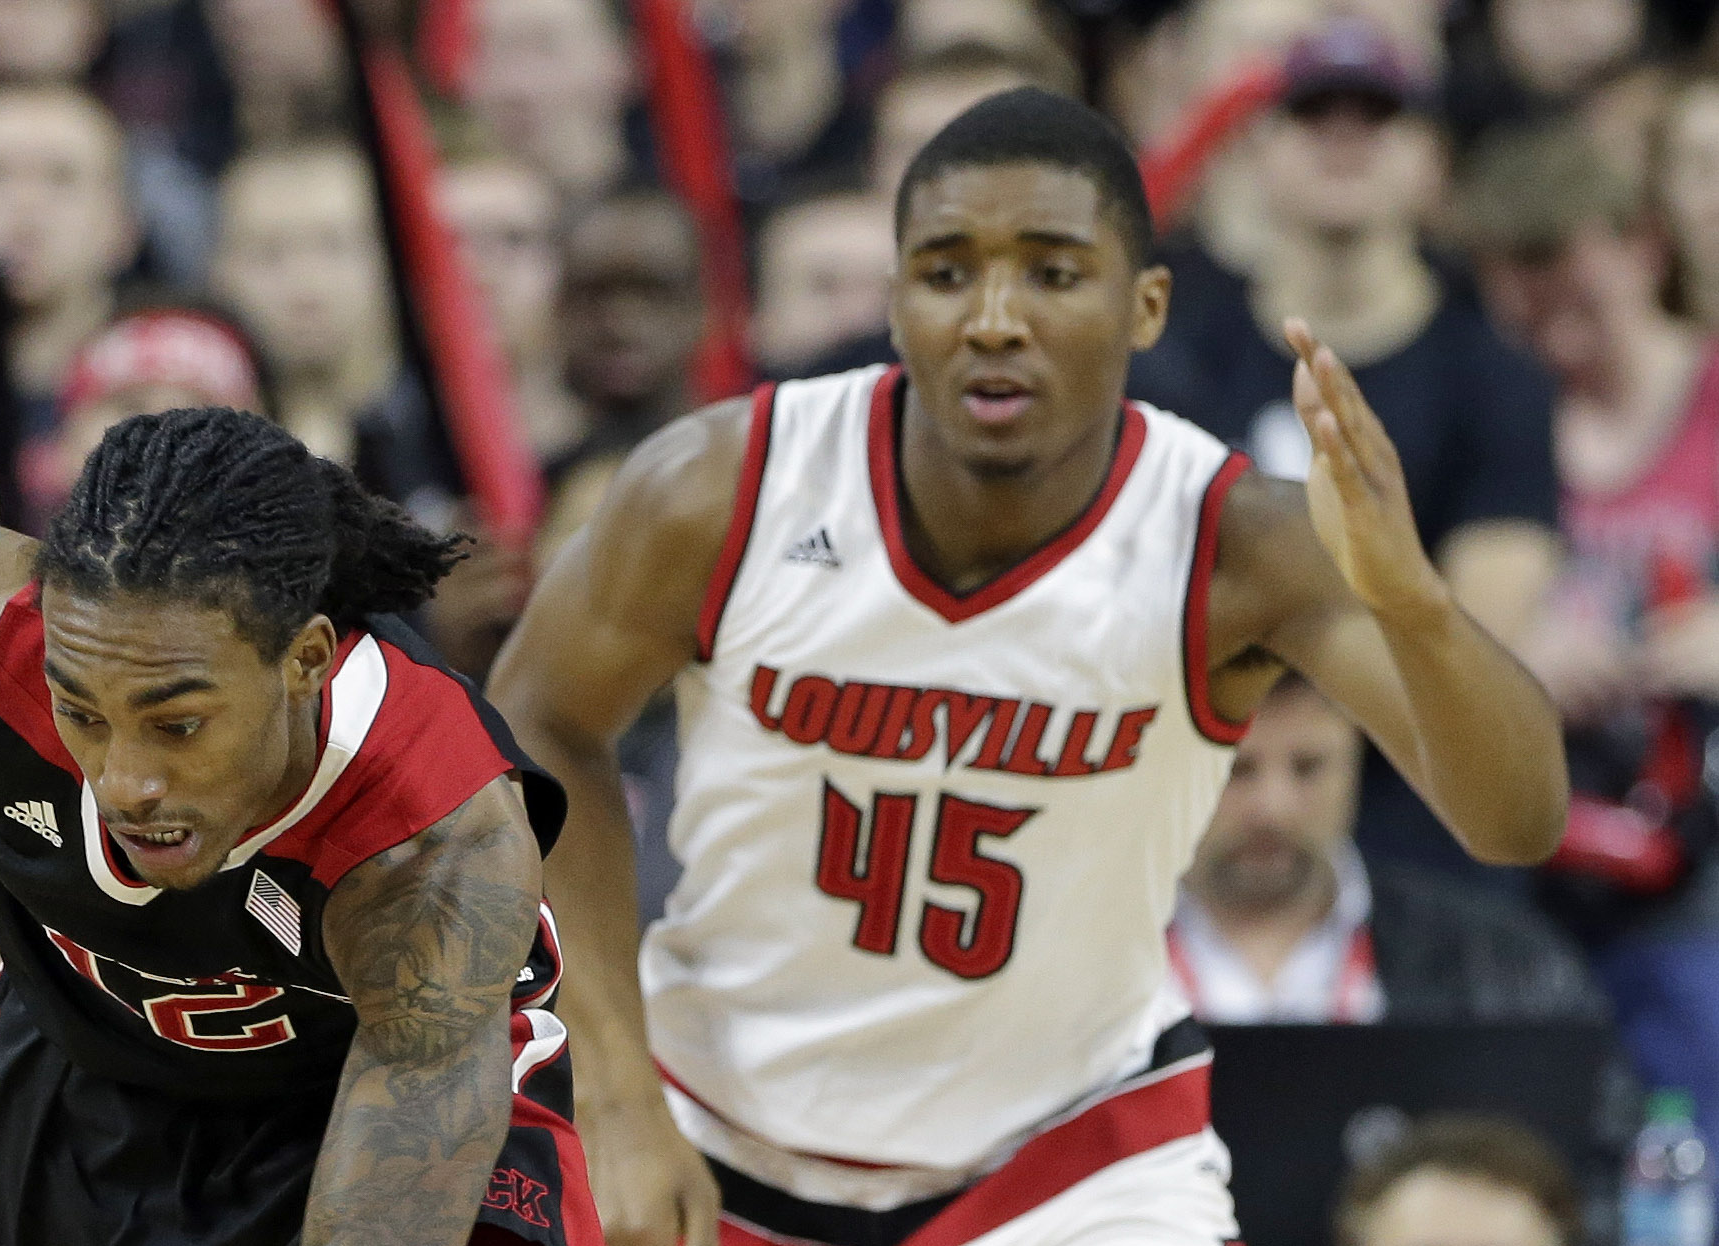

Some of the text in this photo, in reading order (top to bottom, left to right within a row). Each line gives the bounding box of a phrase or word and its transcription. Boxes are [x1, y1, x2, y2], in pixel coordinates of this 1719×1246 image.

[749, 662, 1160, 779] LOUISVILLE
[3, 805, 64, 848] adidas
[817, 773, 1046, 980] 45
